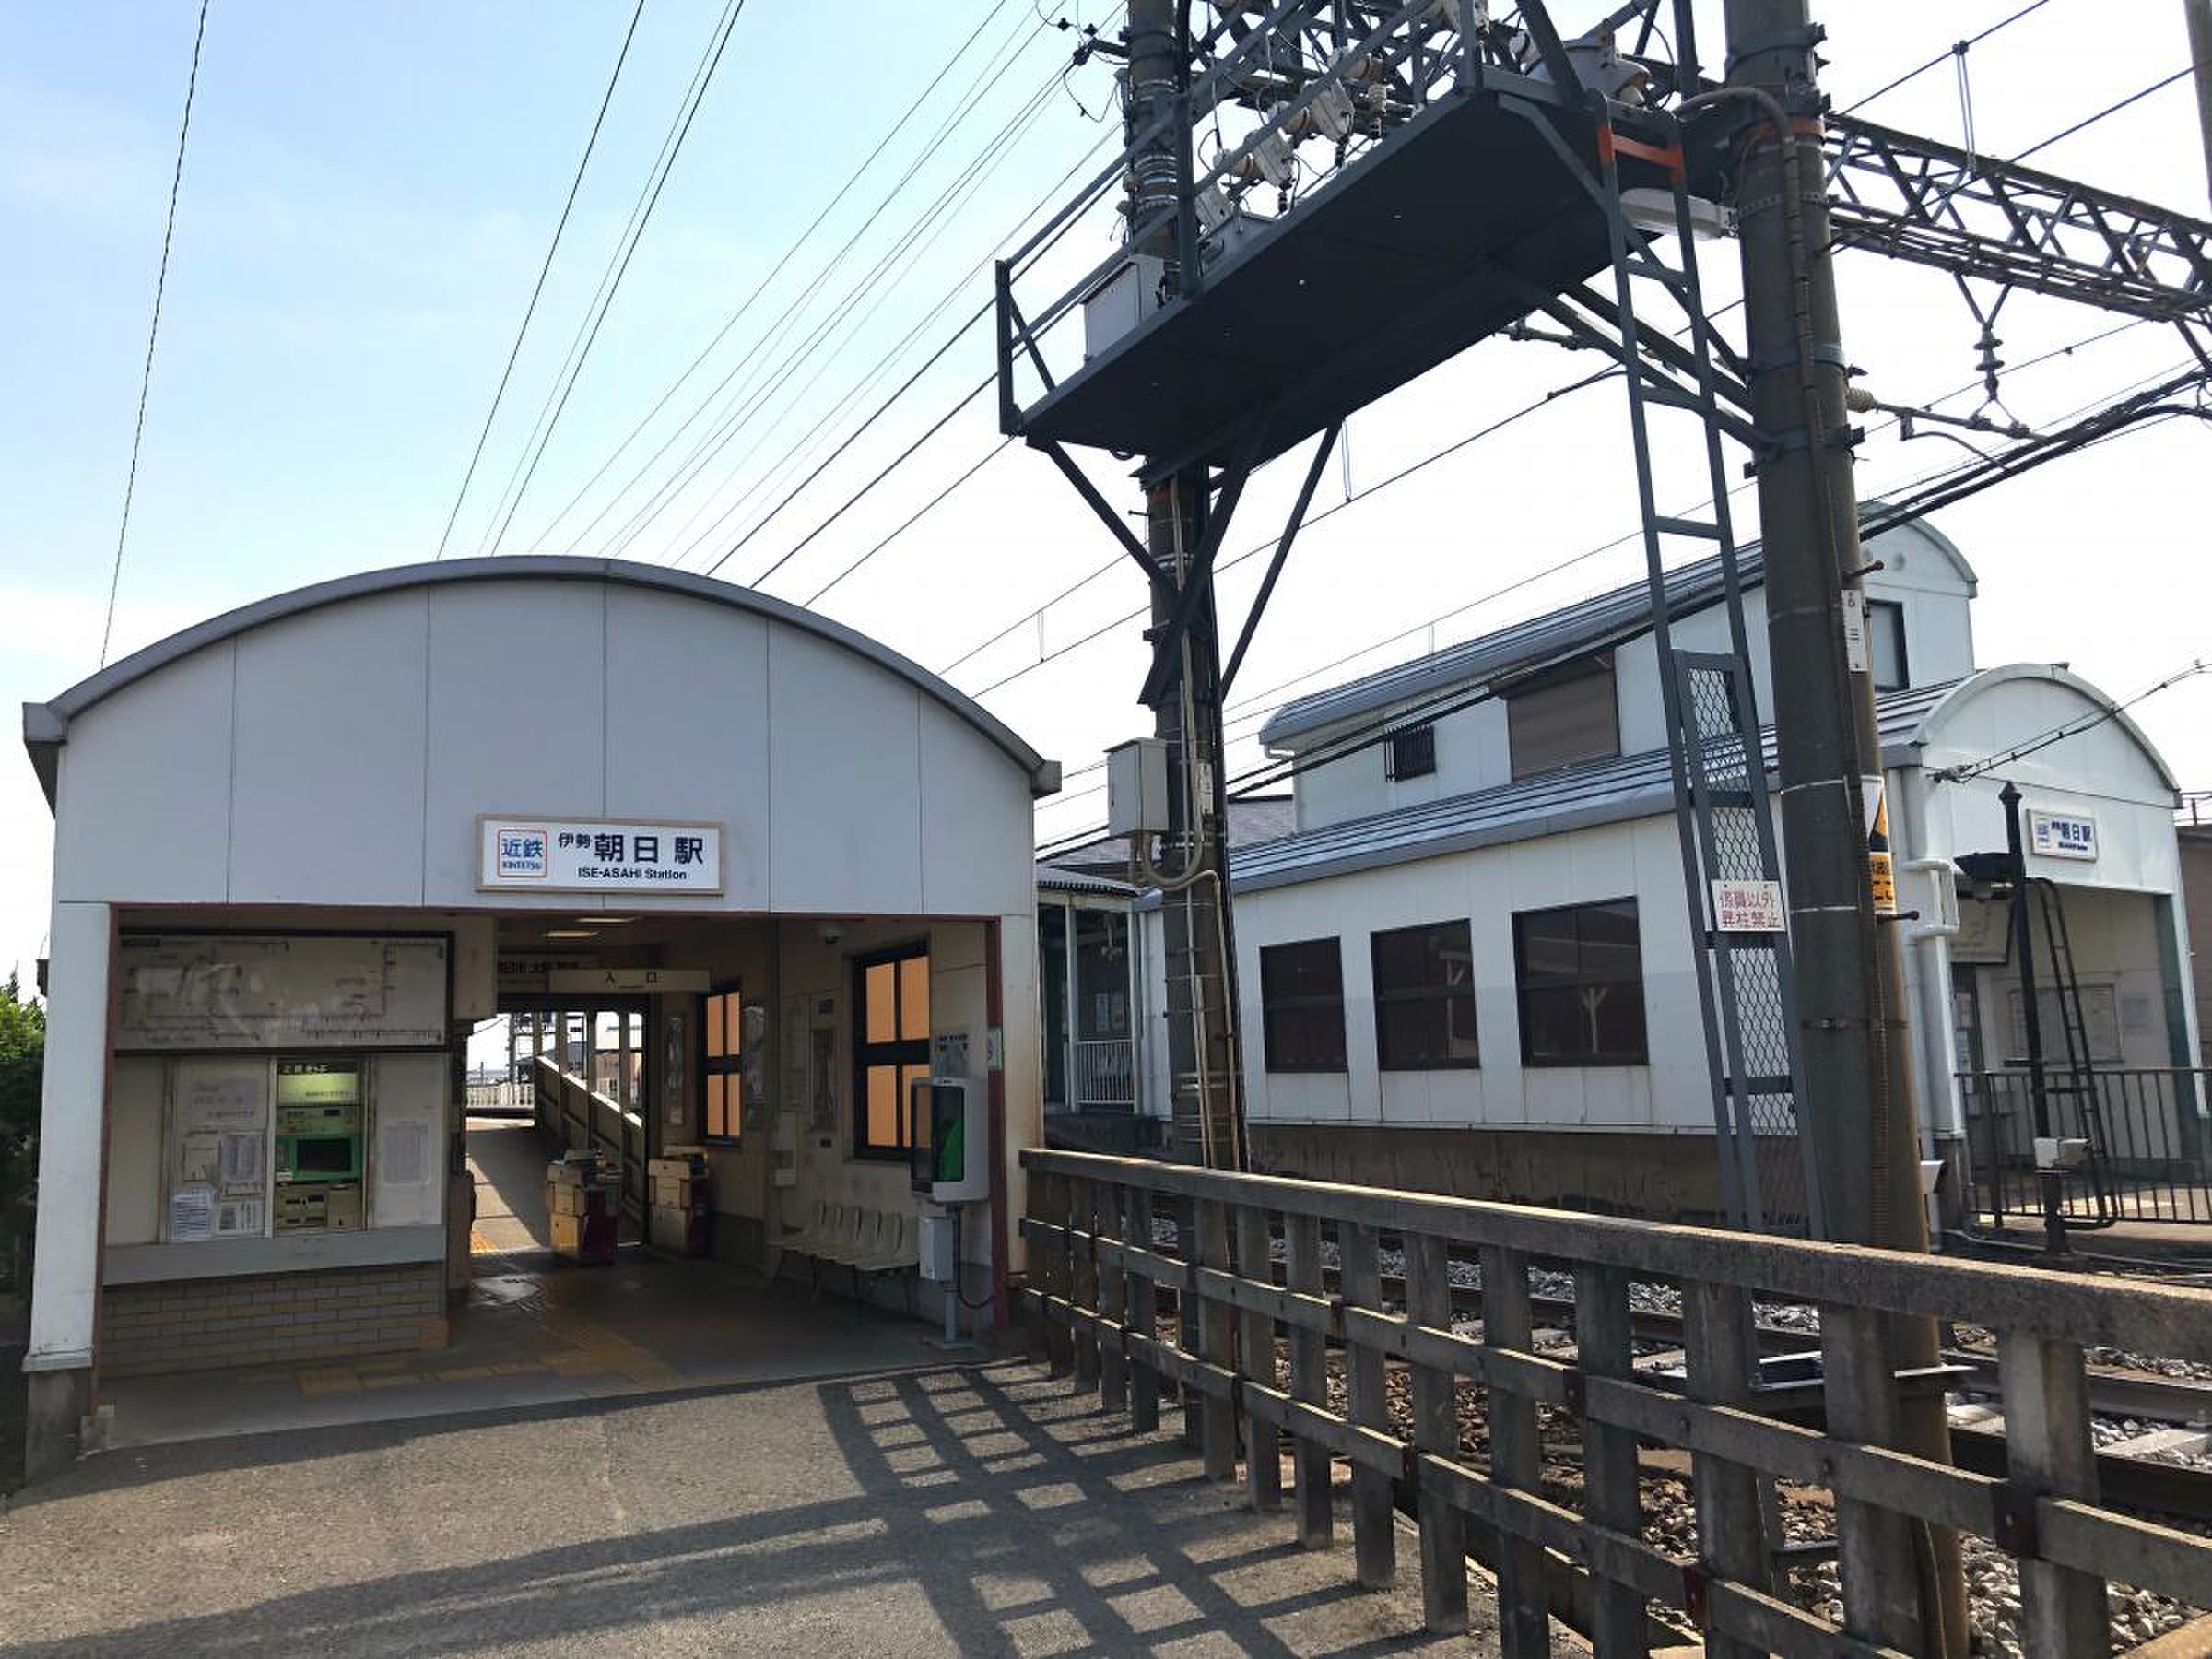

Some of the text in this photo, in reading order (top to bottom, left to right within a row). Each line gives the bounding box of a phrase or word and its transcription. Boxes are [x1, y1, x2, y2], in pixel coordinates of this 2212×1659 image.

[501, 837, 544, 858] 近鉄
[578, 866, 688, 880] ISE-ASAHI Station
